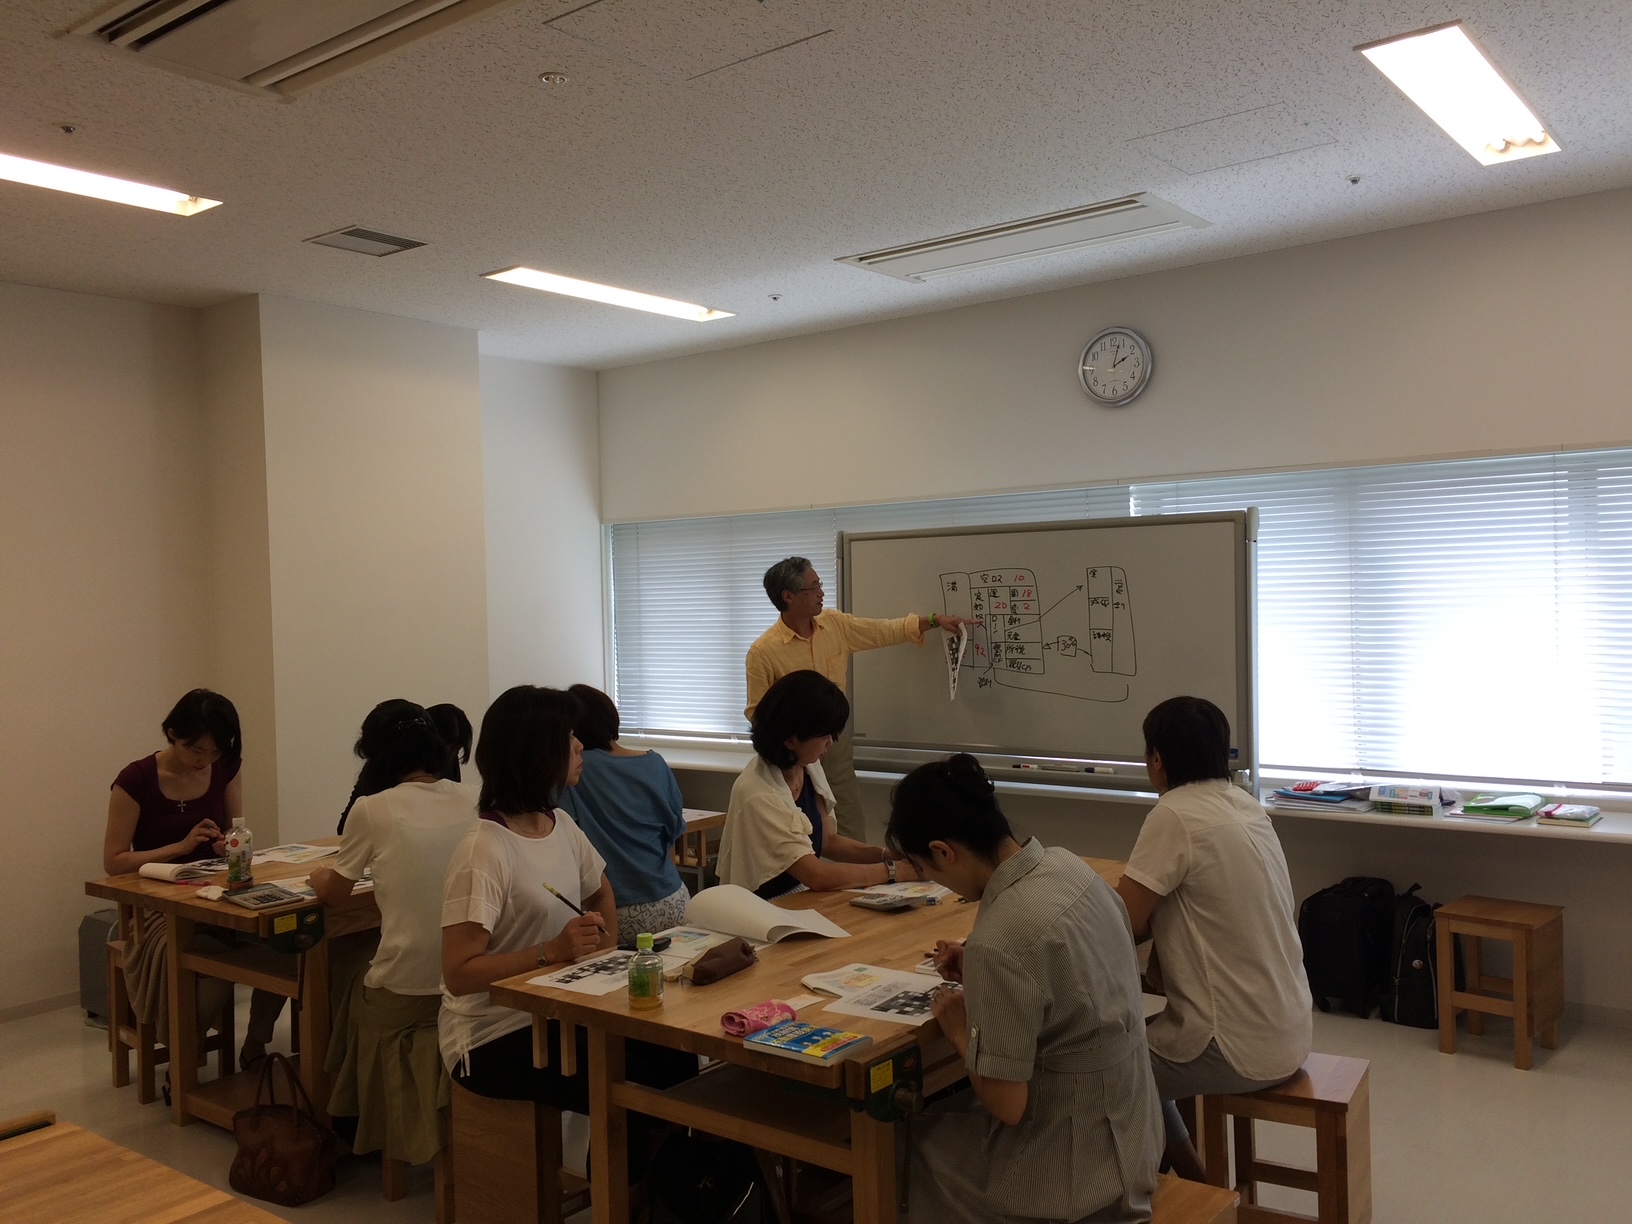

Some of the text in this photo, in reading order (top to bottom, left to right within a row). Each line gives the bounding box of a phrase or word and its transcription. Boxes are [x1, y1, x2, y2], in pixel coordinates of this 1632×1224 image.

[1100, 342, 1106, 351] 11
[1110, 337, 1117, 347] 12
[1130, 345, 1135, 355] 2
[1091, 352, 1099, 362] 10
[1134, 358, 1140, 368] 3
[1130, 371, 1136, 380] 4
[1093, 377, 1099, 386] 8
[1122, 381, 1128, 391] 5
[1102, 384, 1107, 395] 7
[1112, 386, 1118, 396] 6
[1013, 574, 1025, 583] 10
[1022, 589, 1033, 598] 18
[974, 644, 986, 657] 92
